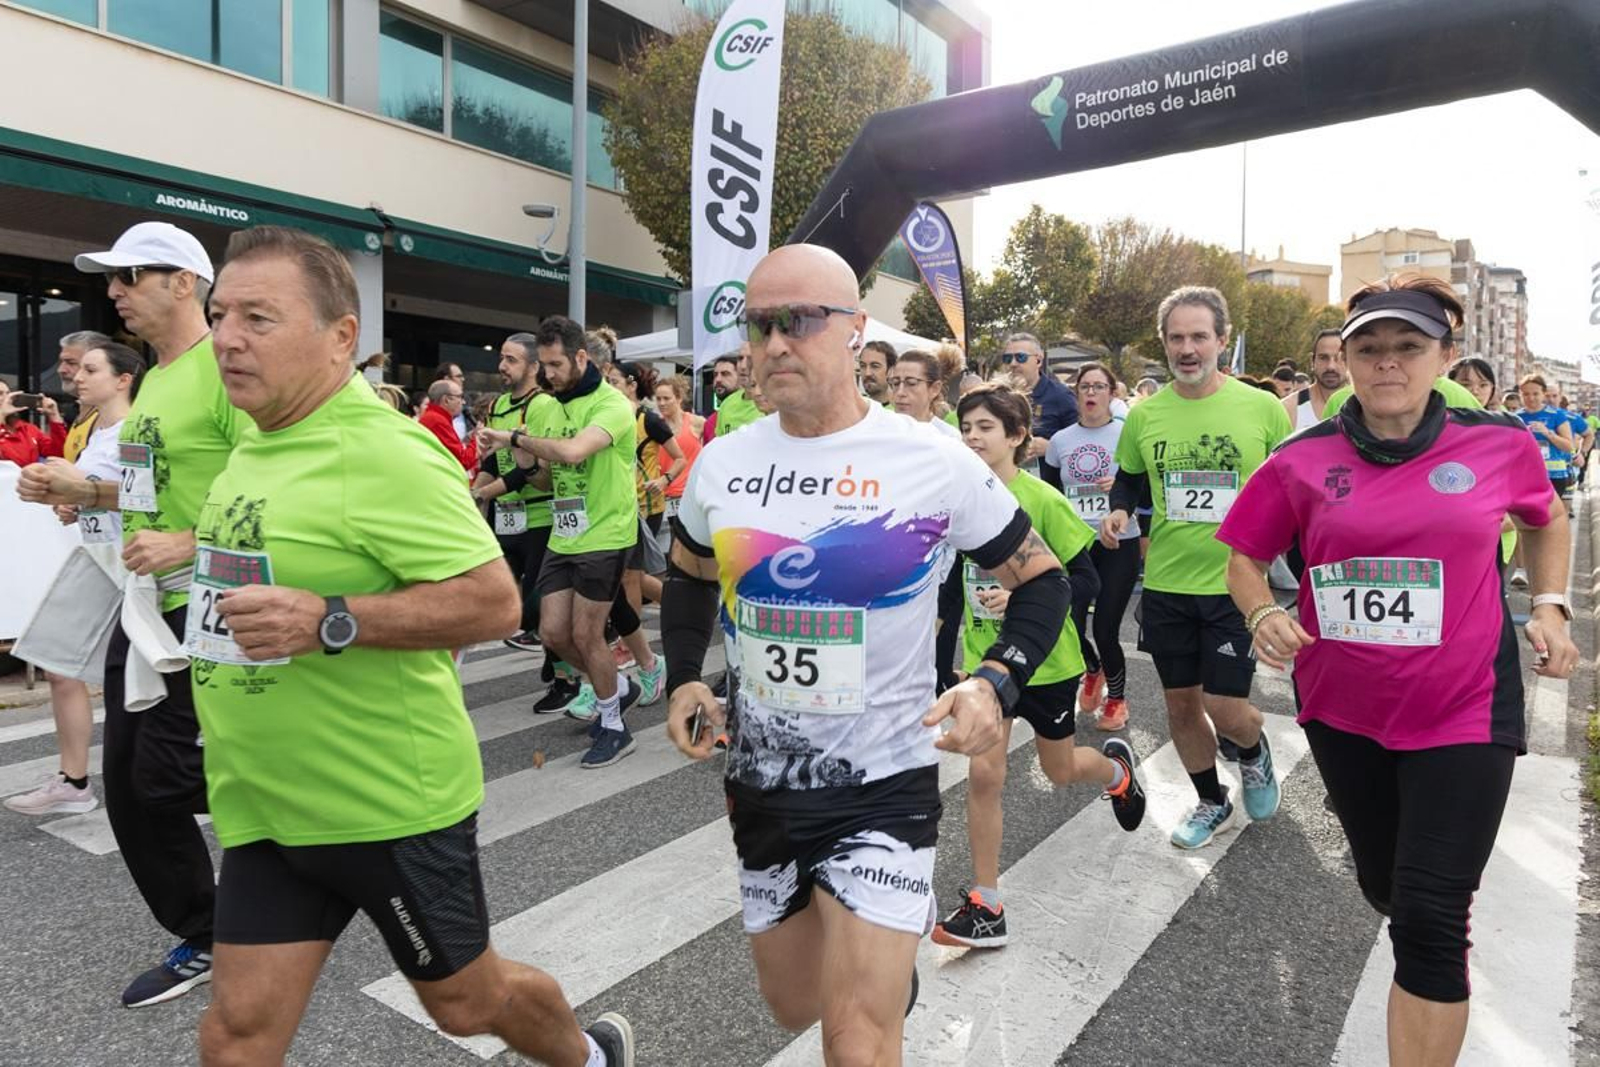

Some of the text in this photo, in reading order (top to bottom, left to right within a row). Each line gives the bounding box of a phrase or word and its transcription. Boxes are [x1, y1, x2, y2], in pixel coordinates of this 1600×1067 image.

[726, 34, 774, 54] CSIF
[1075, 48, 1289, 109] Patronato Municipal de
[1076, 82, 1236, 129] Deportes de Jaén
[705, 107, 763, 250] CSIF
[712, 295, 746, 316] CSI
[1153, 440, 1167, 460] 17
[727, 463, 880, 507] calderón
[1078, 497, 1106, 512] 112
[1185, 489, 1214, 510] 22
[503, 513, 515, 527] 38
[557, 512, 578, 529] 249
[757, 606, 854, 623] CARRERA
[1343, 588, 1414, 624] 164
[758, 619, 854, 637] POPULAR
[765, 644, 819, 687] 35
[851, 864, 930, 897] entrénate
